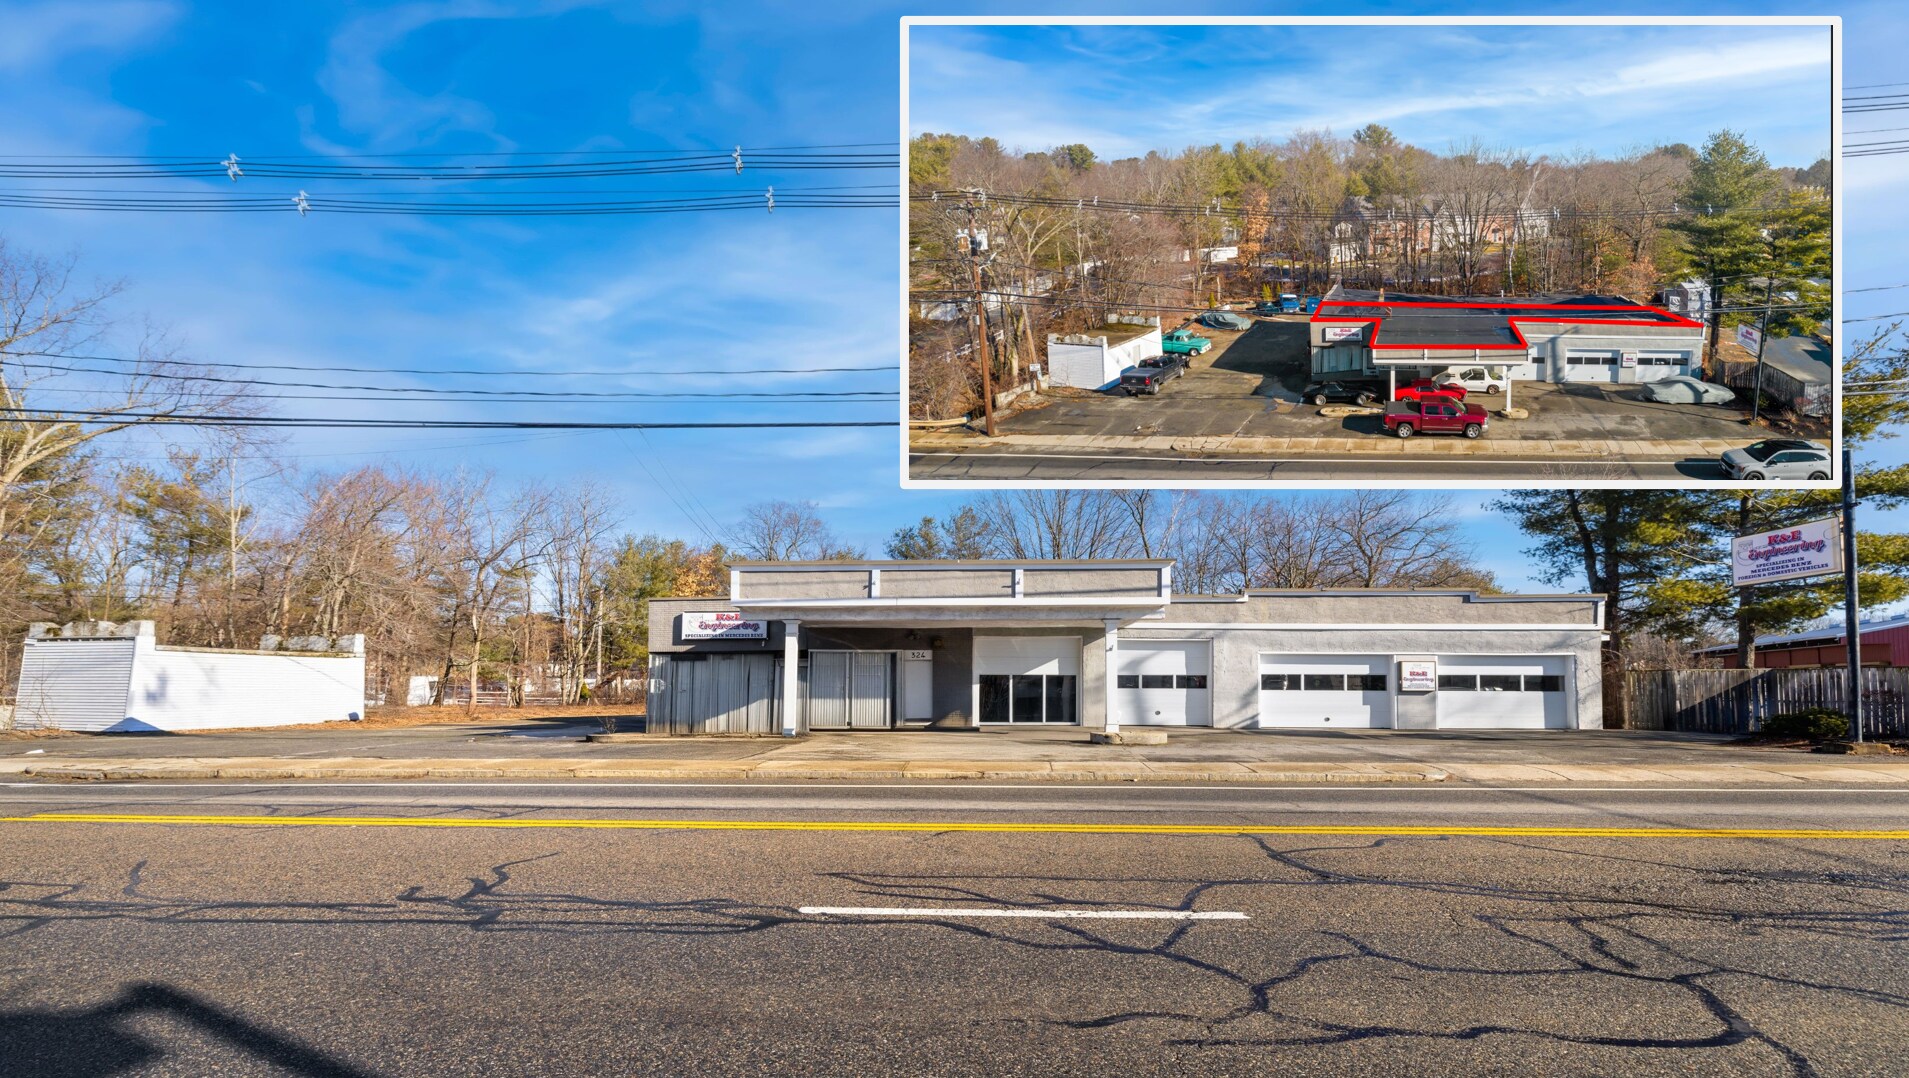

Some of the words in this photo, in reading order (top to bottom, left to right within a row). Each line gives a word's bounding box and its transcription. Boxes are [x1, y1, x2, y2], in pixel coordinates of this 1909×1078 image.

[1767, 529, 1802, 546] K&E
[1748, 539, 1827, 562] Engineering
[1750, 564, 1790, 574] MERCEDES
[1791, 560, 1812, 568] BENZ
[1755, 557, 1795, 568] SPECIALIZING
[1738, 573, 1762, 581] FOREIGN
[1767, 568, 1798, 577] DOMESTIC
[1798, 563, 1829, 572] VEHICLES
[698, 621, 761, 632] Engineering
[911, 651, 926, 659] 324
